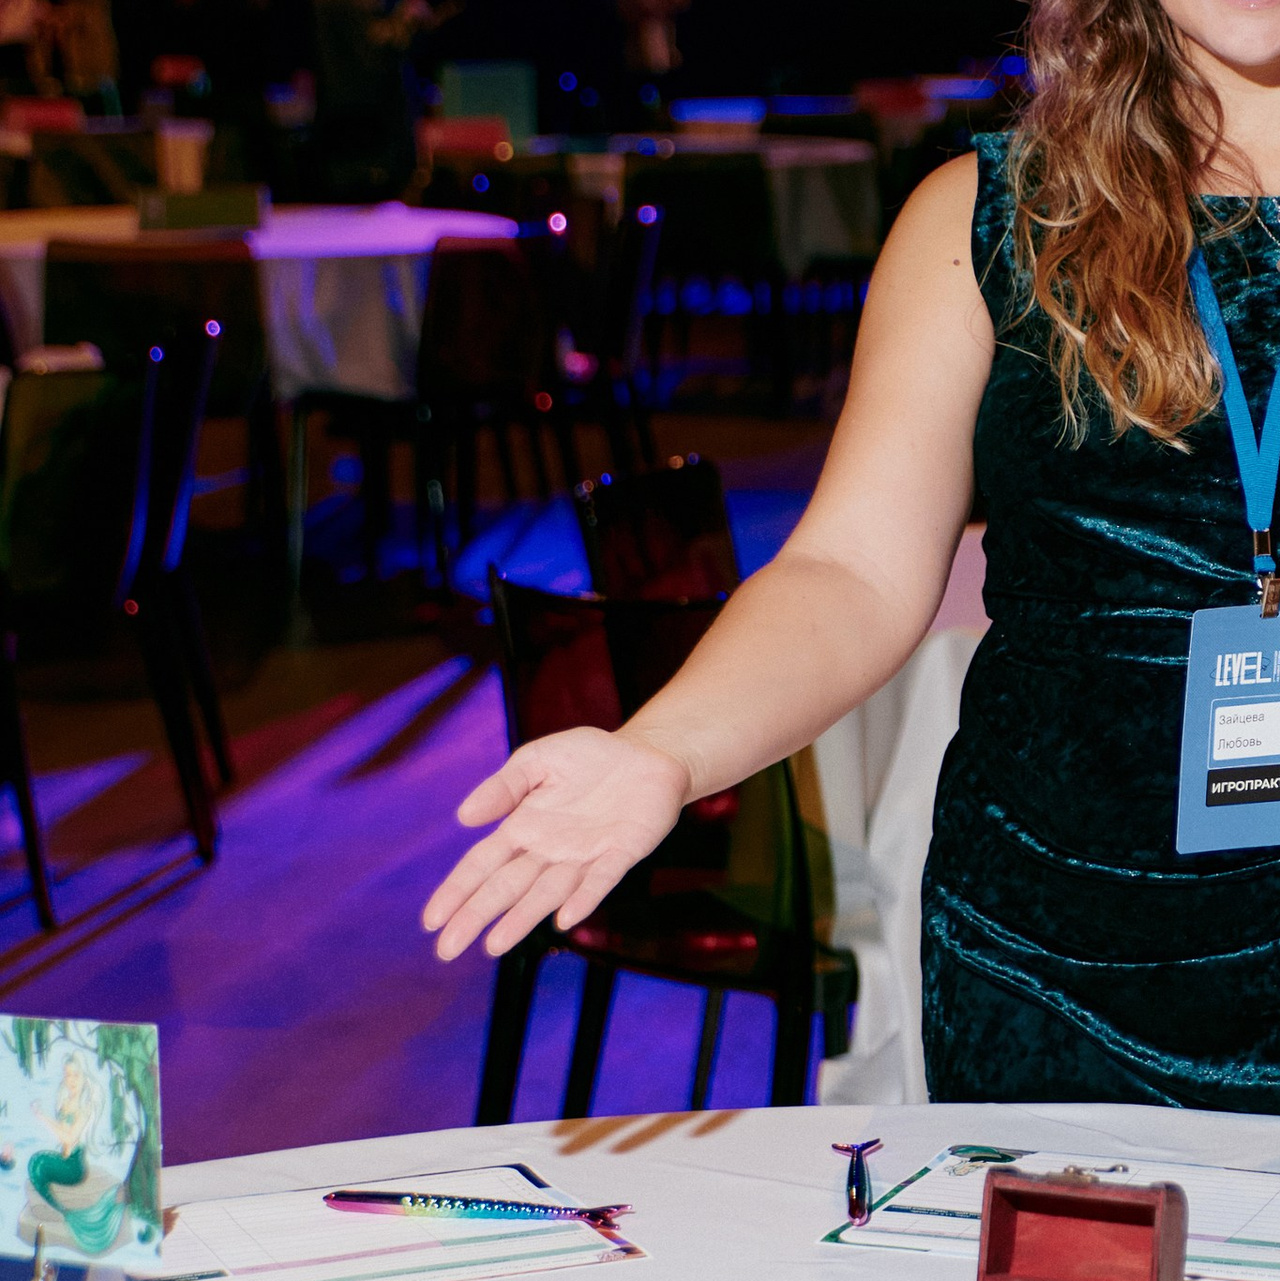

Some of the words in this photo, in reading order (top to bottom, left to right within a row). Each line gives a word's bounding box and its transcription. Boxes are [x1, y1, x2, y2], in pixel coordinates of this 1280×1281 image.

[1215, 651, 1272, 687] LEVEL
[1218, 712, 1265, 726] Зайцева
[1217, 737, 1262, 751] Любовь
